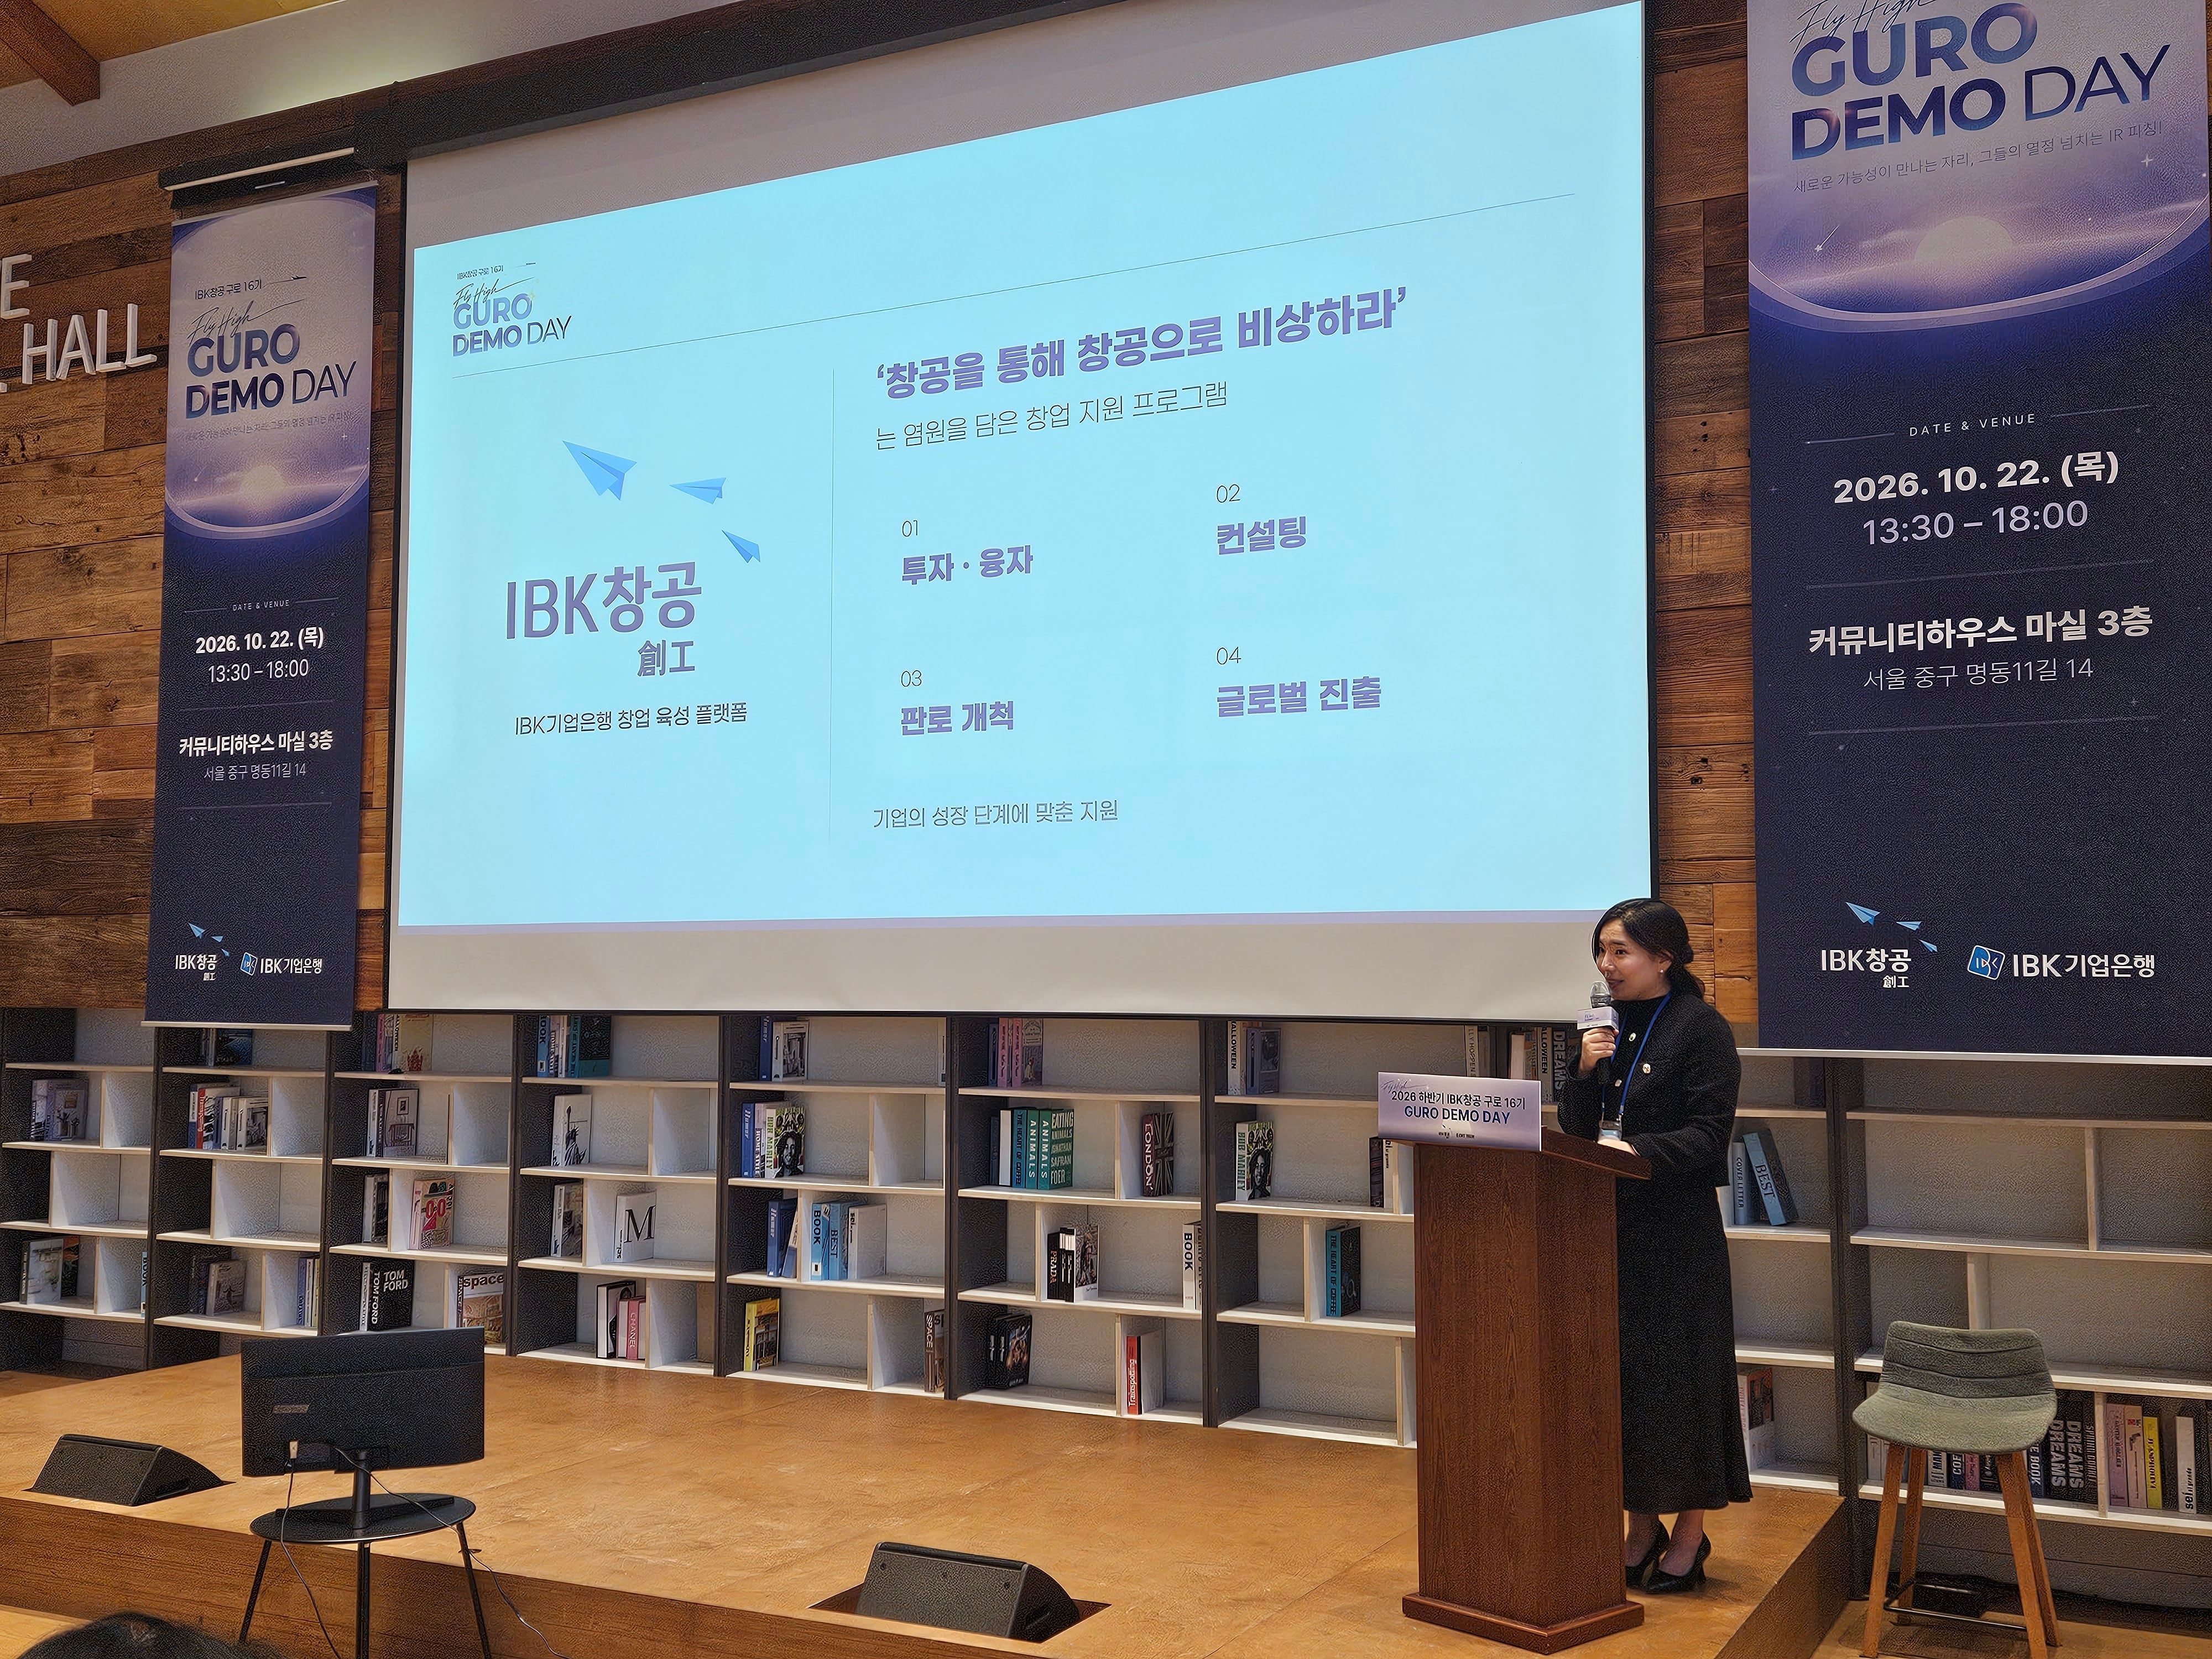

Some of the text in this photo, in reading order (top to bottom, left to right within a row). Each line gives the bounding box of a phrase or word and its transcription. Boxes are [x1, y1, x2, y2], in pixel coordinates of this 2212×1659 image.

[1792, 3, 2037, 97] GURO
[1792, 44, 2171, 160] DEMO DAY
[1793, 175, 1834, 193] 새로운
[1838, 165, 1891, 186] 가능성이
[1896, 159, 1937, 176] 만나는
[1941, 152, 1974, 168] 자리,
[1977, 144, 2021, 163] 그들의
[2026, 138, 2054, 156] 열정
[2060, 133, 2103, 151] 넘치는
[2109, 128, 2124, 142] IR
[244, 279, 263, 291] 16기
[453, 293, 533, 330] GURO
[22, 303, 158, 385] HALL
[187, 324, 301, 377] GURO
[453, 315, 572, 357] DEMO DAY
[997, 341, 1065, 383] 통해
[1078, 316, 1223, 372] 창공으로
[186, 361, 357, 419] DEMO DAY
[875, 380, 1228, 451] 는 염원을 담은 창업 지원 프로그램
[1910, 414, 2036, 437] DATE & VENUE
[1834, 451, 2119, 503] 2026. 10. 22. (목)
[1216, 484, 1241, 504] 02
[901, 519, 920, 538] 01
[1217, 516, 1308, 556] 컨설팅
[1863, 511, 1954, 545] 13:30
[1991, 500, 2088, 534] 18:00
[901, 552, 954, 586] 투자
[979, 545, 1034, 580] 융자
[233, 603, 252, 611] DATE
[264, 599, 290, 608] VENUE
[506, 561, 702, 639] IBK창공
[196, 627, 324, 654] 2026. 10. 22. (목)
[1808, 606, 2153, 656] 커뮤니티하우스 마실 3층
[208, 663, 251, 683] 13:30
[267, 659, 309, 679] 18:00
[637, 639, 696, 677] 創工
[1216, 646, 1241, 666] 04
[901, 670, 922, 688] 03
[1863, 658, 2094, 691] 서울 중구 명동11길 14
[1217, 676, 1382, 718] 글로벌 진출
[515, 702, 748, 735] IBK기업은행 창업 육성 플랫폼
[901, 700, 1015, 736] 판로 개척
[179, 729, 334, 757] 커뮤니티하우스 마실 3층
[204, 762, 306, 781] 서울 중구 명동11길 14
[873, 800, 1119, 830] 기업의 성장 단계에 맞춘 지원
[175, 954, 217, 971] IBK창공
[260, 958, 323, 974] IBK기업은행
[1820, 948, 1912, 972] IBK창공
[2013, 953, 2156, 978] IBK기업은행
[1882, 974, 1911, 989] 創工
[1391, 1091, 1525, 1110] 2026 하반기 IBK창공 구로 16기
[1404, 1105, 1511, 1125] GURO DEMO DAY
[1051, 1112, 1073, 1129] EATING
[1145, 1123, 1154, 1190] LONDON
[1051, 1169, 1065, 1185] FOER
[1755, 1163, 1776, 1198] BEST
[624, 1205, 656, 1244] M
[1184, 1232, 1193, 1271] BOOK
[383, 1269, 405, 1282] TOM
[383, 1279, 409, 1292] FORD
[463, 1274, 505, 1289] space
[2049, 1419, 2067, 1488] DREAMS
[2066, 1420, 2084, 1489] DREAMS
[2030, 1455, 2042, 1486] BOOK
